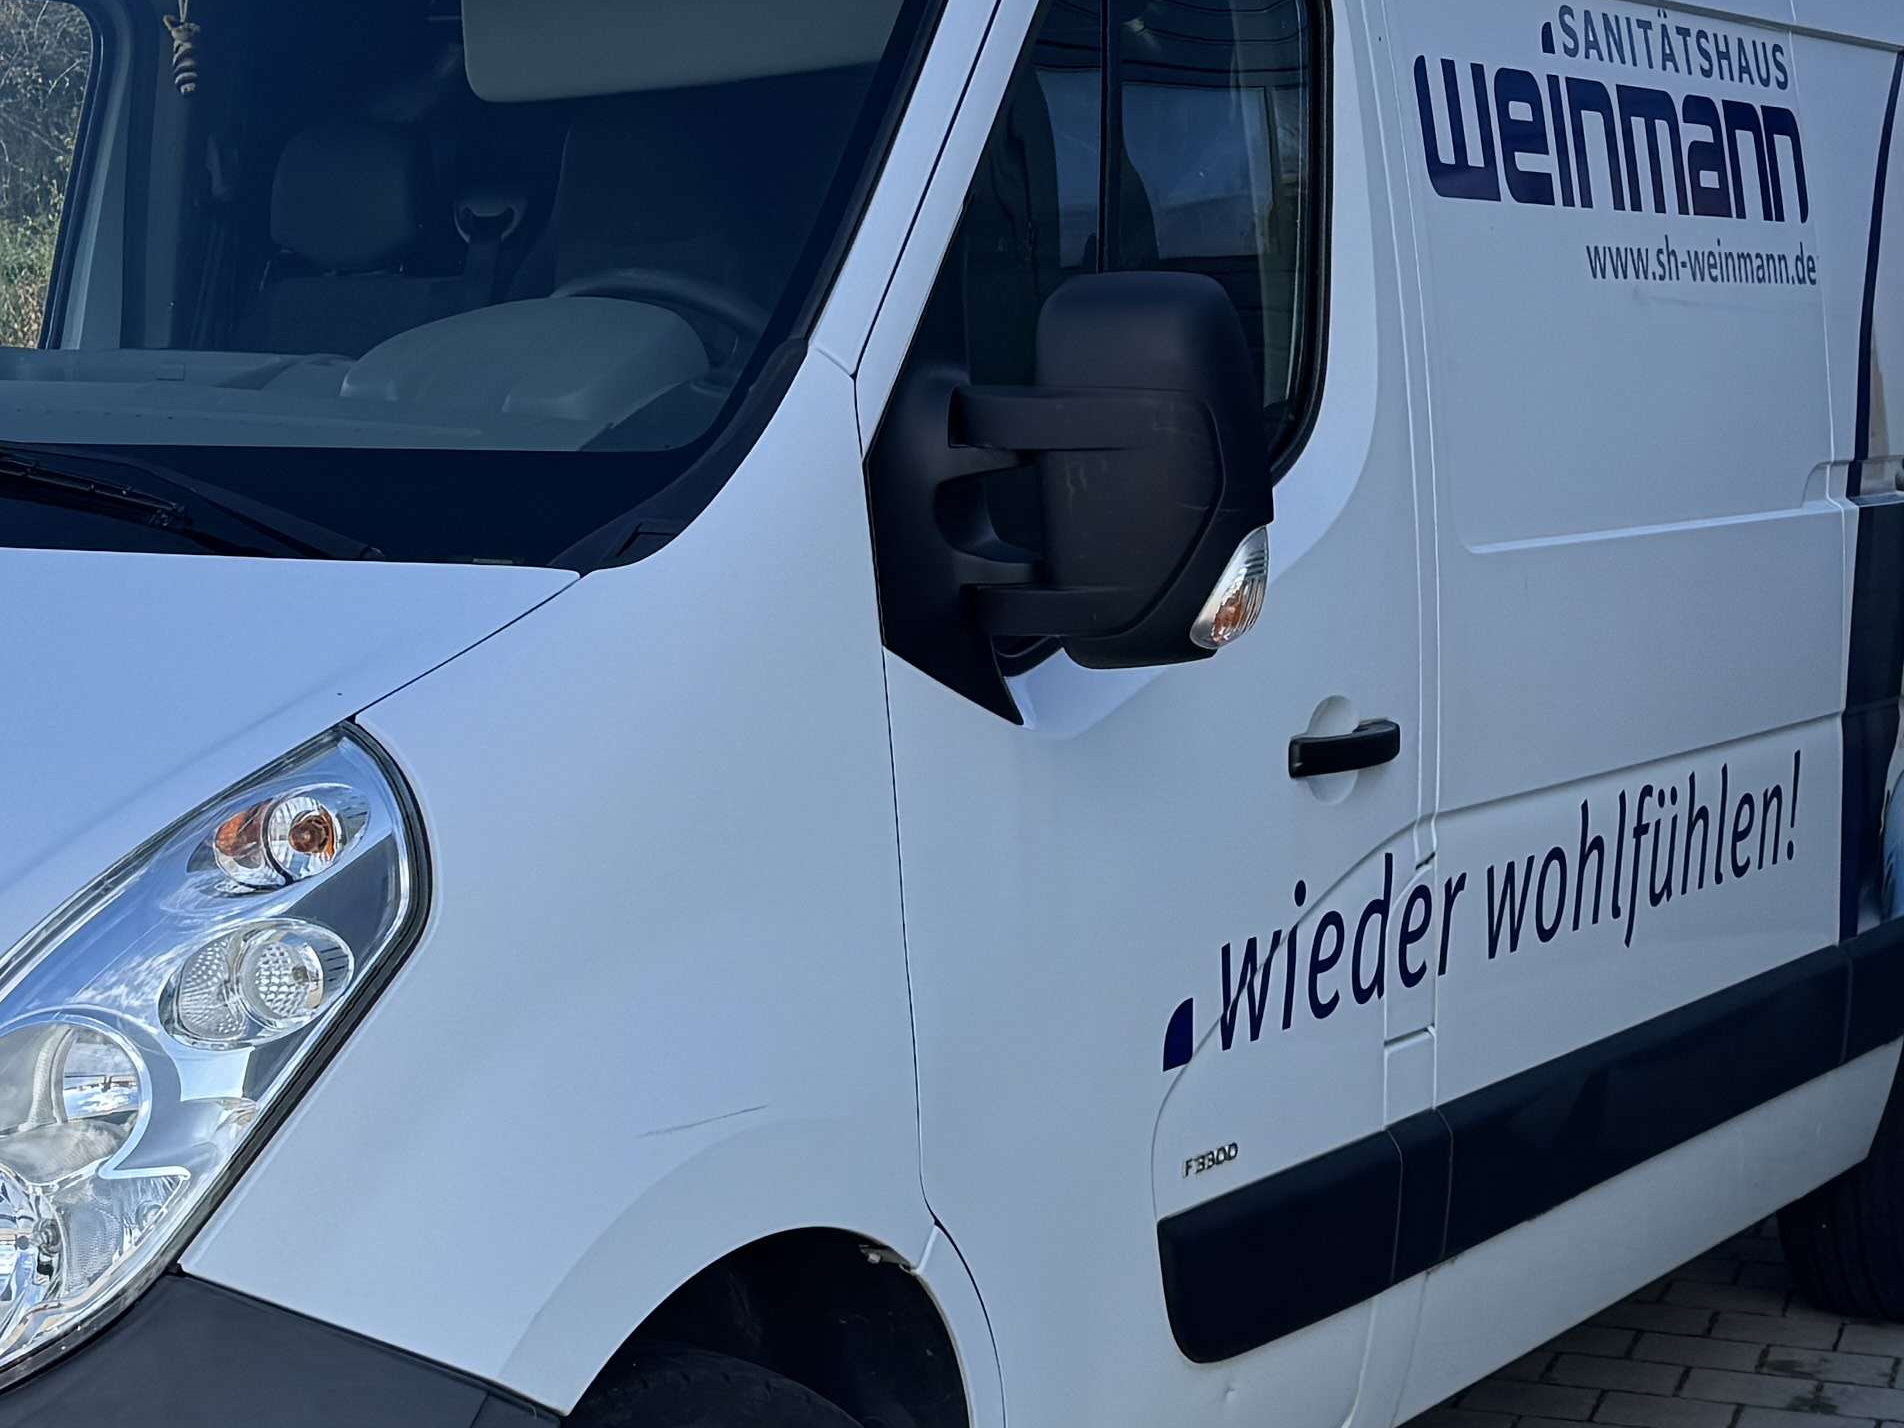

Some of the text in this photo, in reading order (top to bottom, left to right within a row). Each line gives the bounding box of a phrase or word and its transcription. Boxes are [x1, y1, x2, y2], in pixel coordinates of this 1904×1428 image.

[1557, 4, 1788, 90] SANITÄTSHAUS
[1586, 236, 1817, 286] www.sh-weinmann.de
[1220, 750, 1802, 1052] wieder wohlfühlen!
